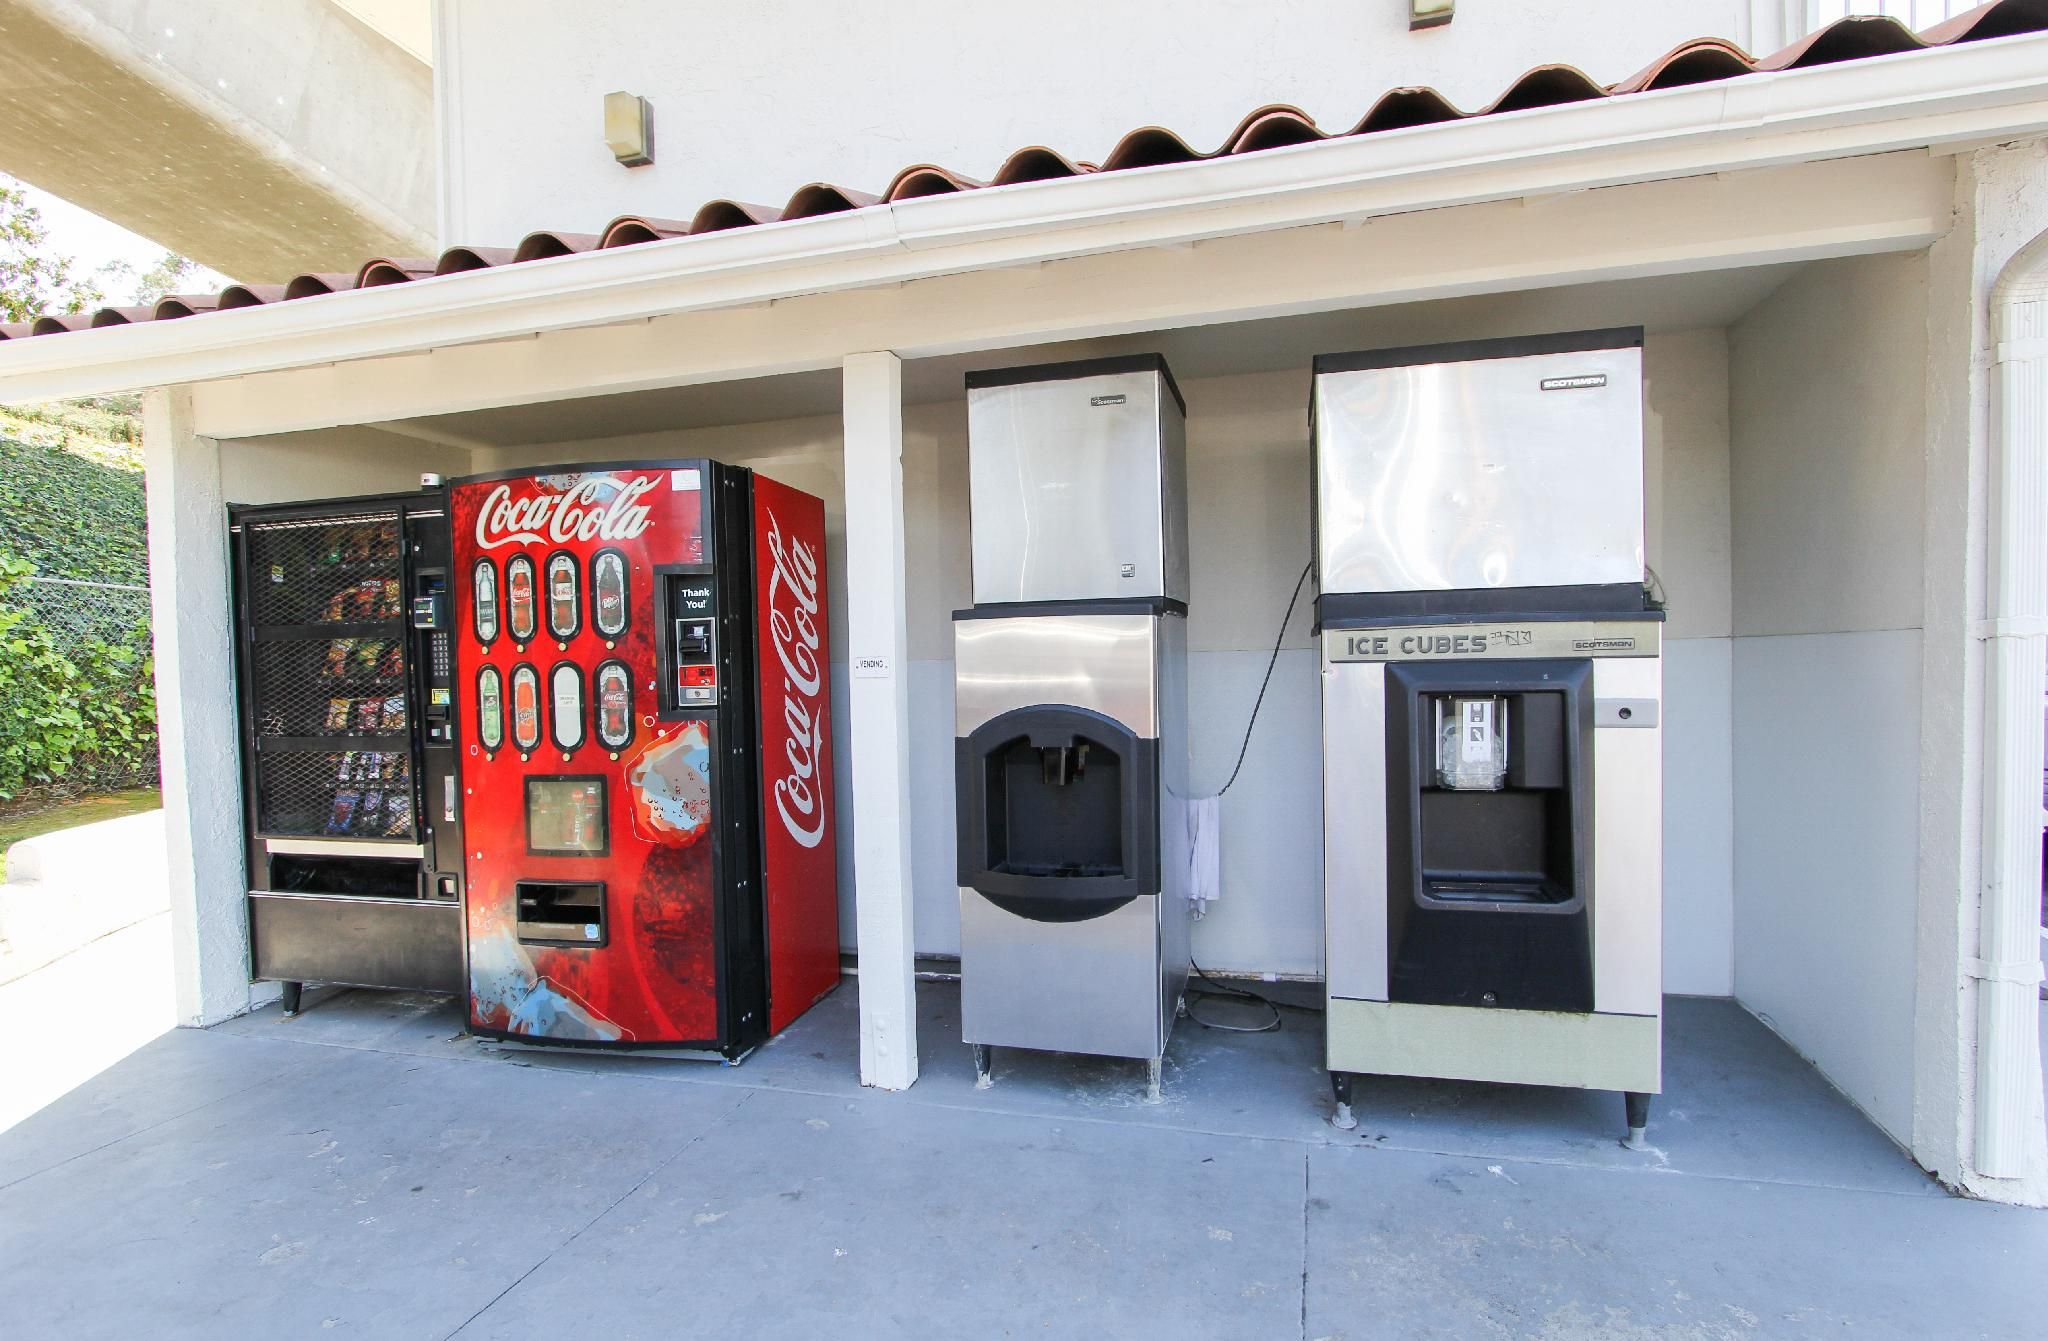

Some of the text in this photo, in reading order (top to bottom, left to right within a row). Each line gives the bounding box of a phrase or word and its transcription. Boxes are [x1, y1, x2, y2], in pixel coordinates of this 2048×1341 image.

[1543, 377, 1604, 387] SCOTSMAN
[475, 473, 664, 549] Coca-Cola
[682, 588, 710, 598] Thank
[686, 600, 706, 609] You!
[1347, 637, 1388, 655] ICE
[1400, 635, 1487, 654] CUBES
[1575, 641, 1632, 649] SCOTSMAN
[766, 506, 825, 848] Coca-Cola
